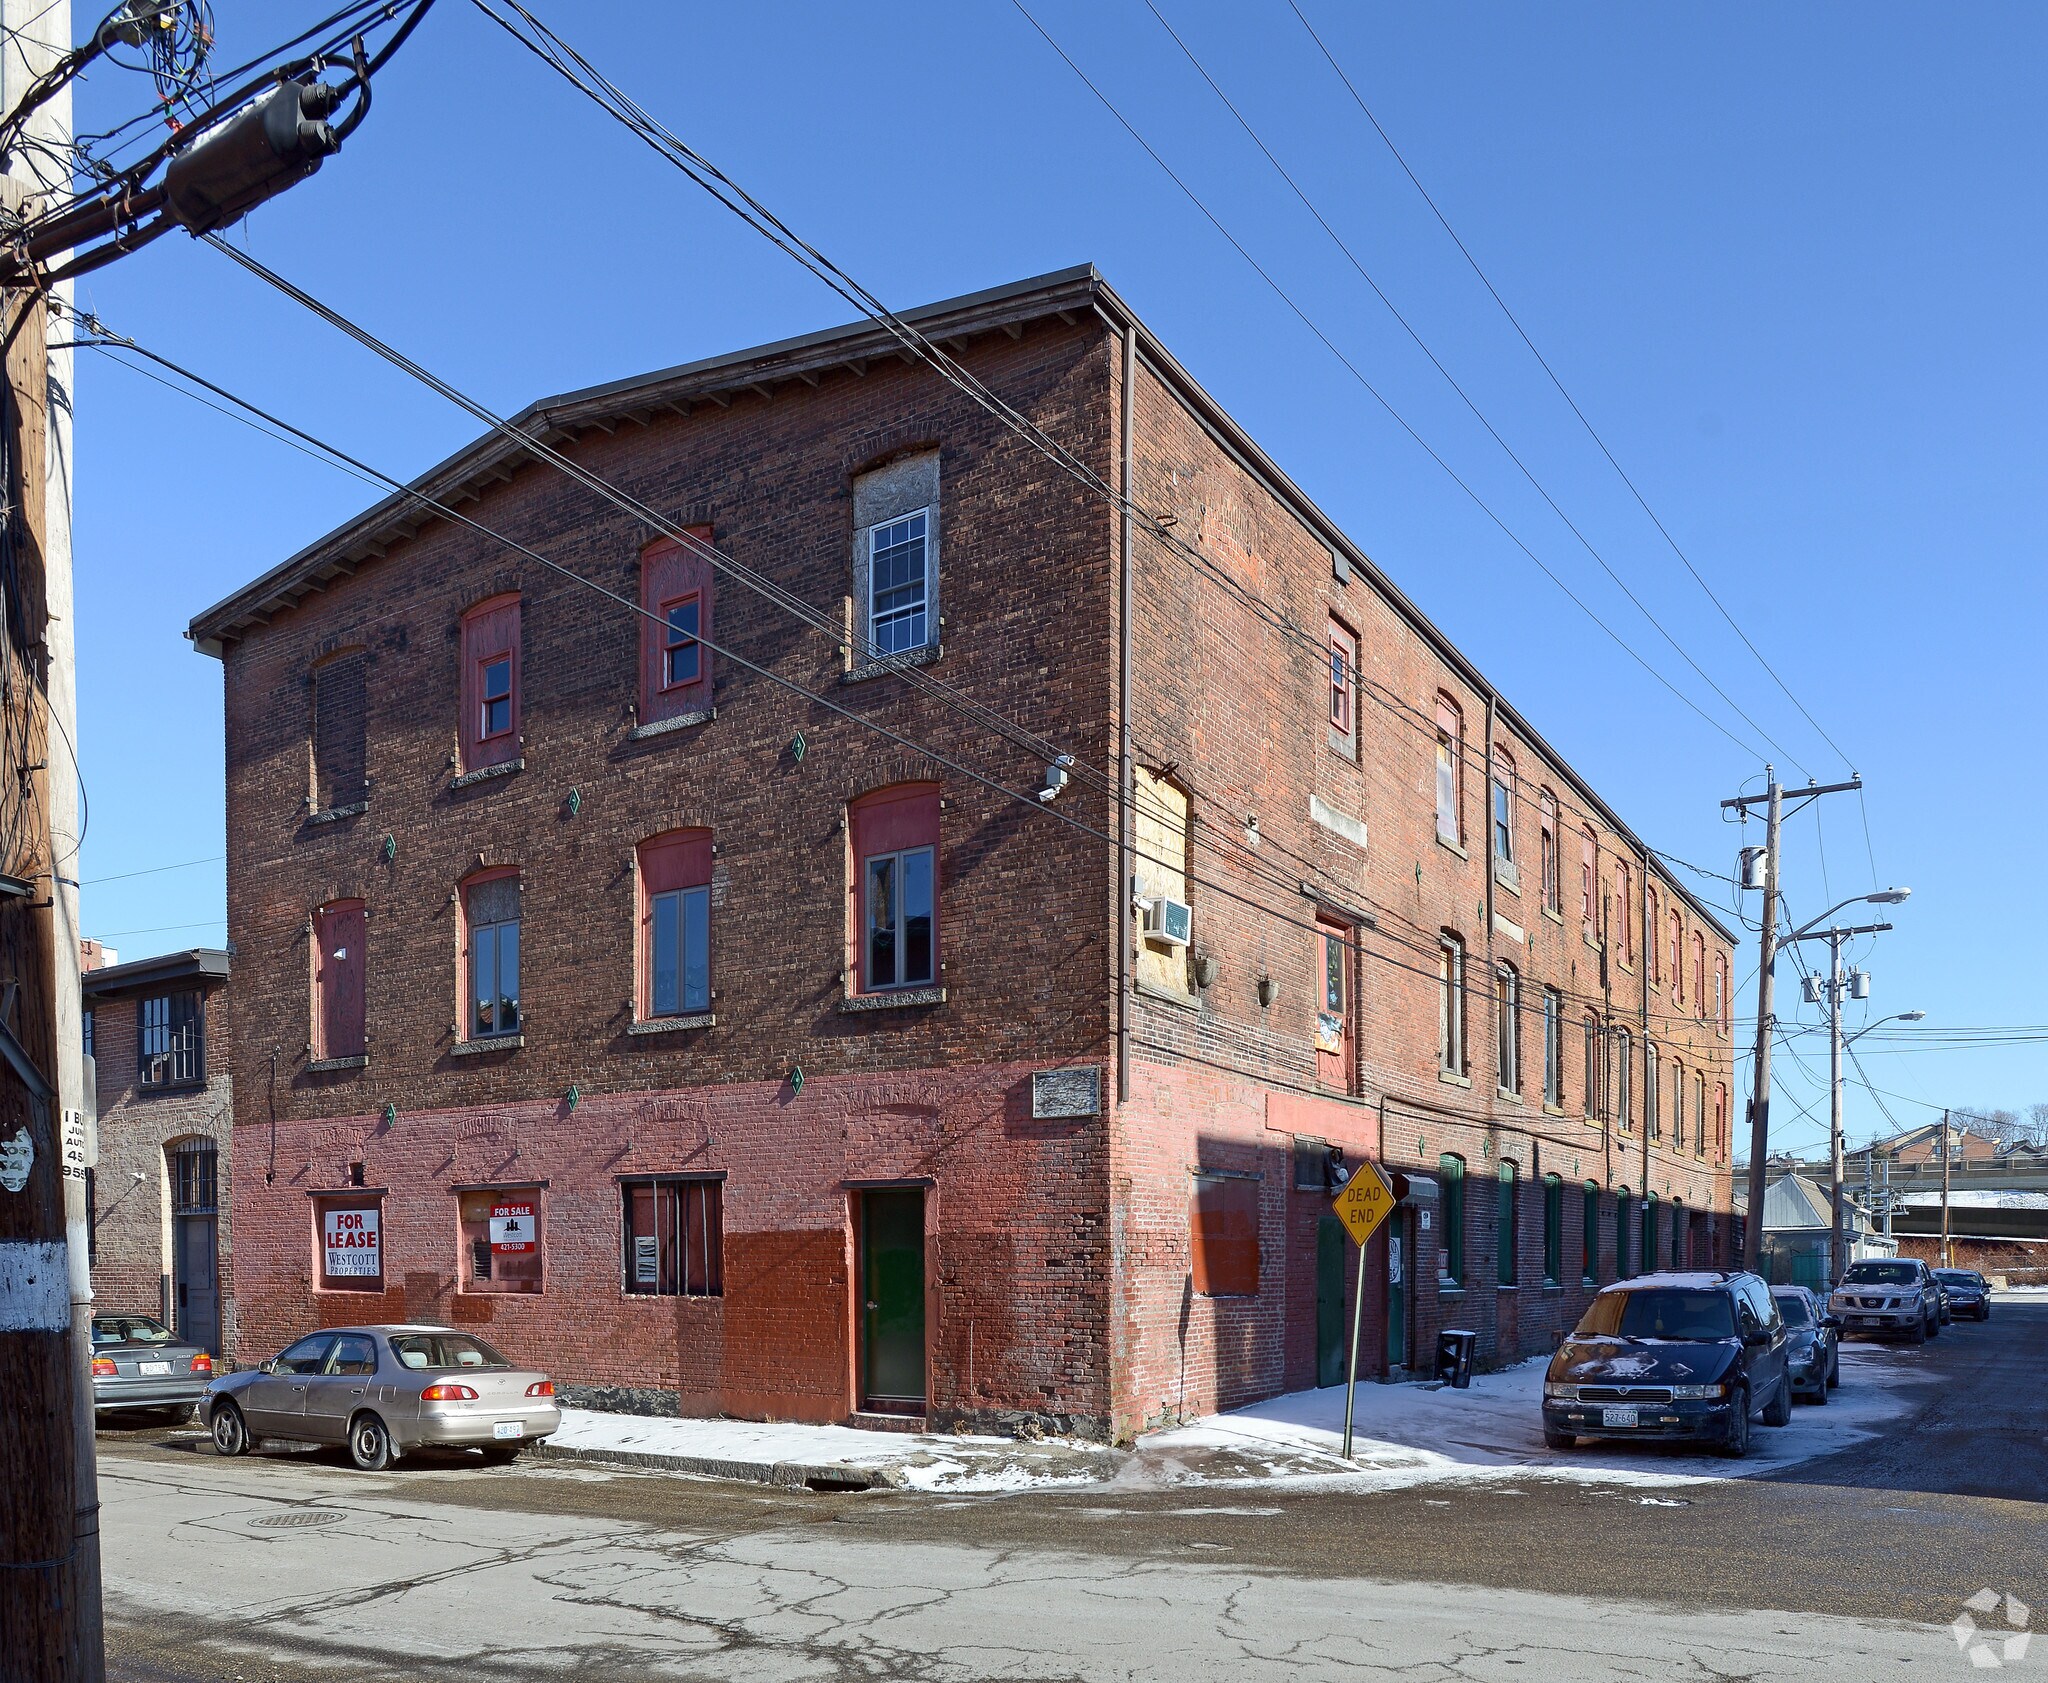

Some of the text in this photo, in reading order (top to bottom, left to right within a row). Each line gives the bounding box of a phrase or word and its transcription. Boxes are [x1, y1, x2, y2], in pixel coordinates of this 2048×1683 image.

[1347, 1187, 1381, 1202] DEAD
[495, 1206, 530, 1216] FOR SALE
[1350, 1209, 1374, 1223] END
[337, 1214, 364, 1229] FOR
[327, 1232, 376, 1248] LEASE
[328, 1252, 376, 1265] WESTCOTT
[330, 1267, 376, 1275] PROPERTIES
